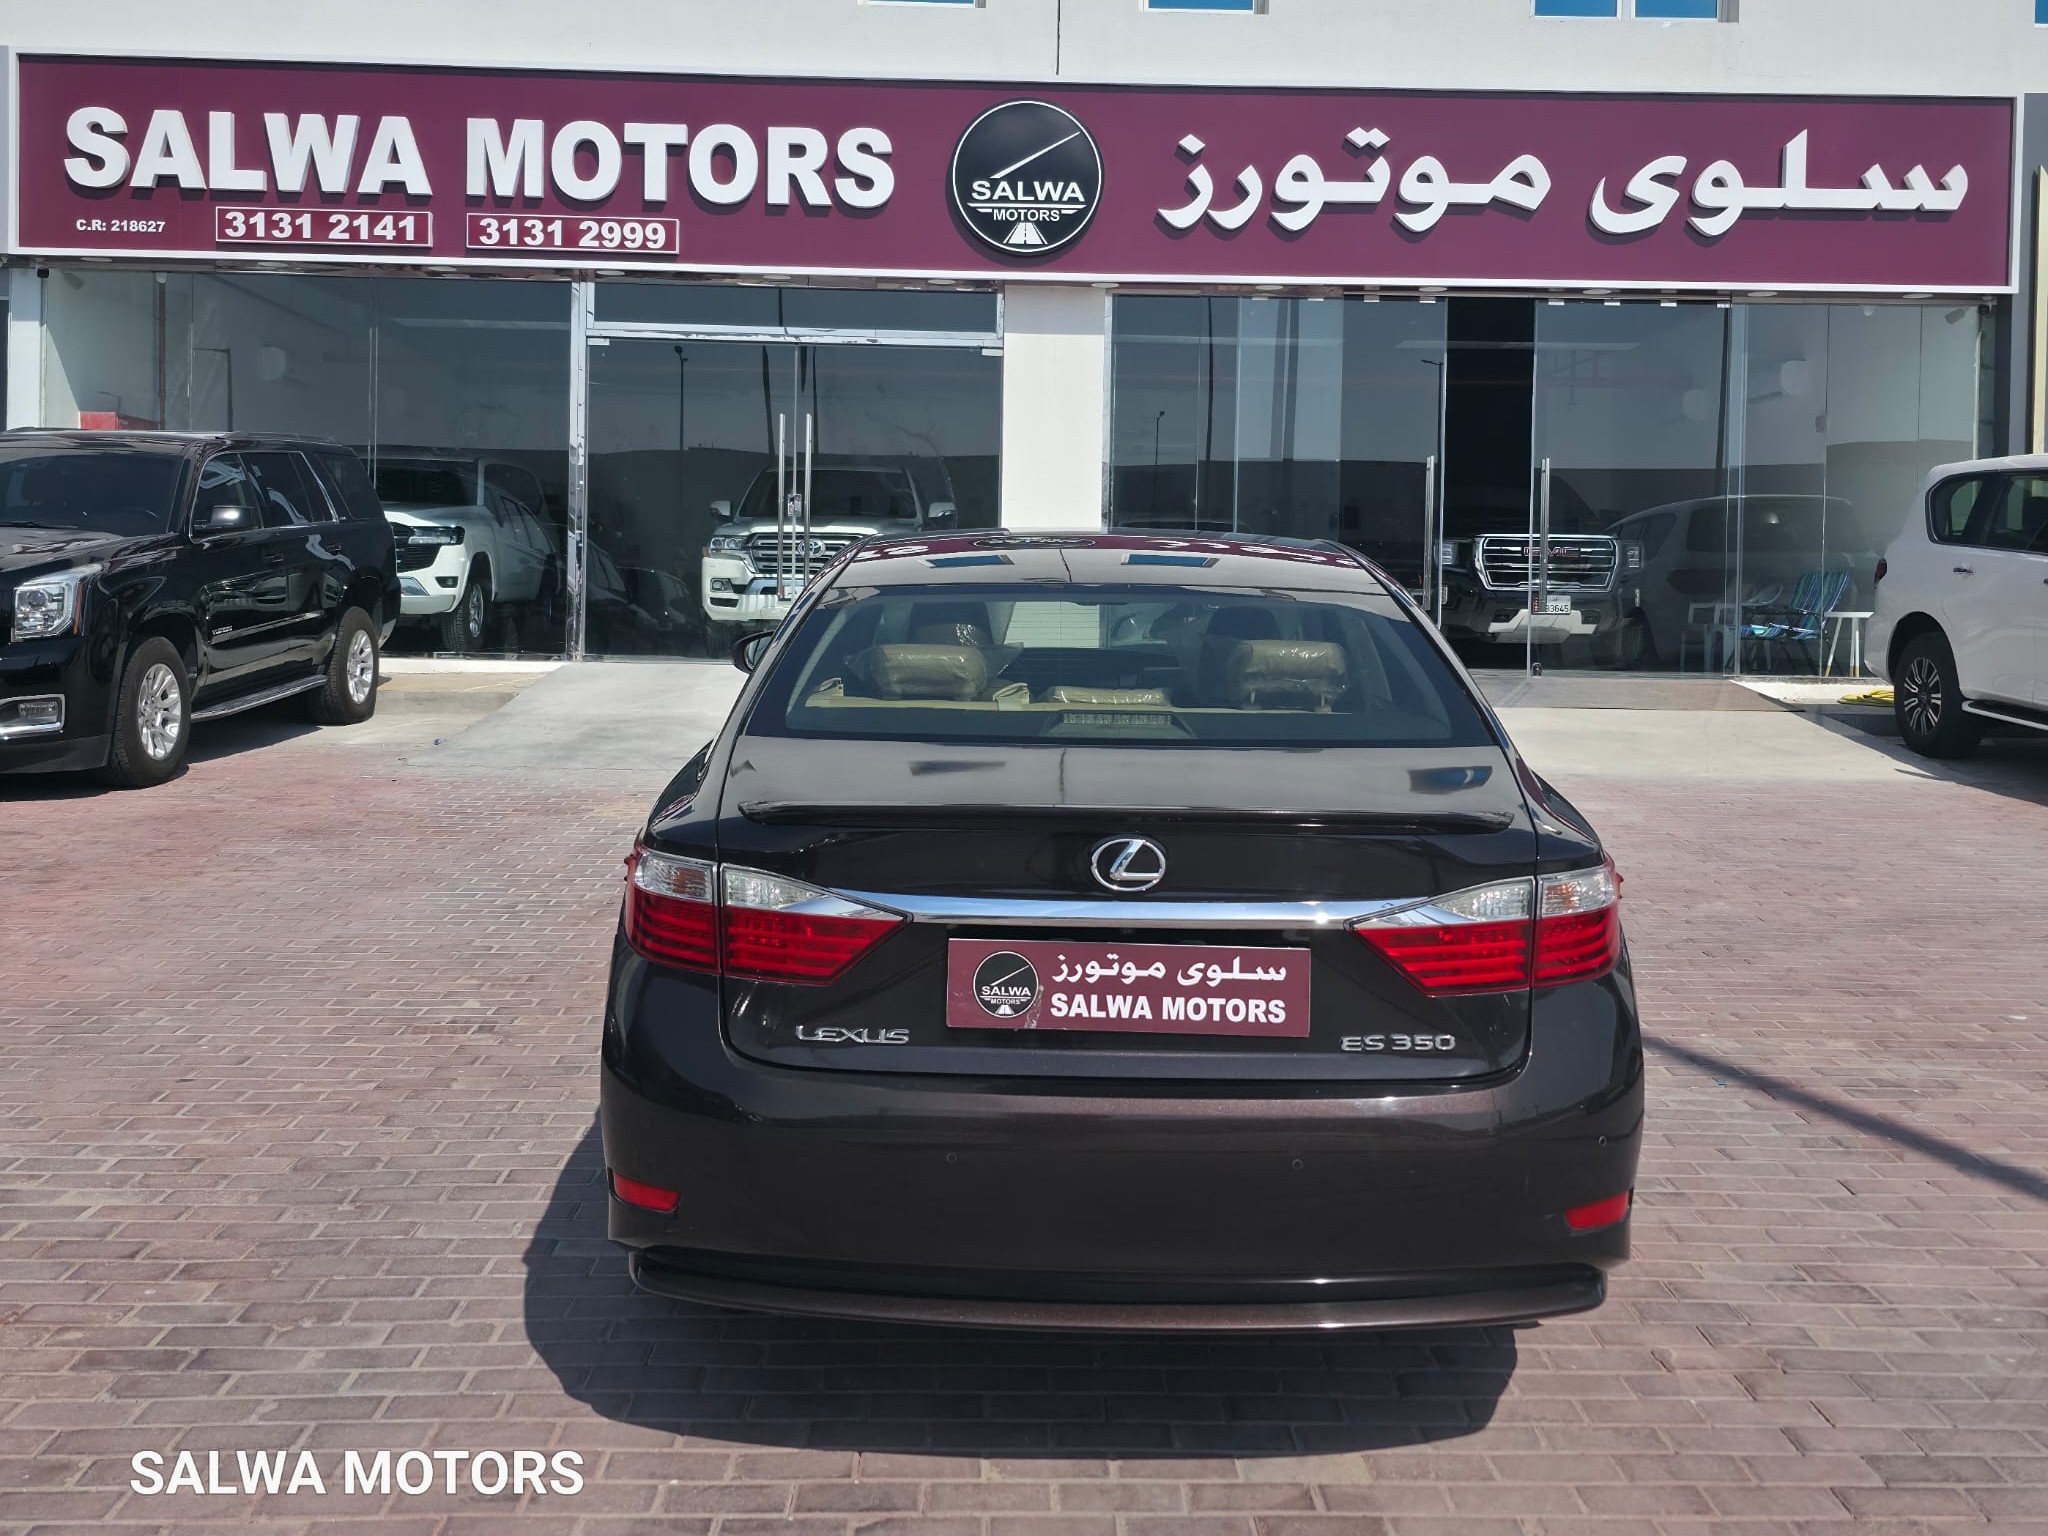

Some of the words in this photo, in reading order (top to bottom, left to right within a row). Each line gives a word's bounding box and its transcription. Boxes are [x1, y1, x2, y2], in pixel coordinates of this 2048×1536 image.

[64, 106, 433, 196] SALWA
[466, 117, 895, 207] MOTORS
[971, 179, 1086, 202] SALWA
[1157, 126, 1552, 232] موتورز
[1590, 129, 1969, 236] سلوى
[75, 219, 107, 231] C.R:
[110, 219, 166, 233] 218627
[224, 211, 313, 239] 3131
[328, 214, 417, 242] 2141
[992, 208, 1061, 223] MOTORS
[478, 219, 563, 247] 3131
[578, 221, 667, 250] 2999
[1051, 953, 1167, 985] موتورز
[1176, 956, 1287, 987] سلوى
[981, 985, 1032, 997] SALWA
[1050, 992, 1153, 1020] SALWA
[1161, 996, 1287, 1024] MOTORS
[795, 1025, 910, 1045] LEXUS
[1340, 1034, 1385, 1051] ES
[1390, 1034, 1456, 1051] 350
